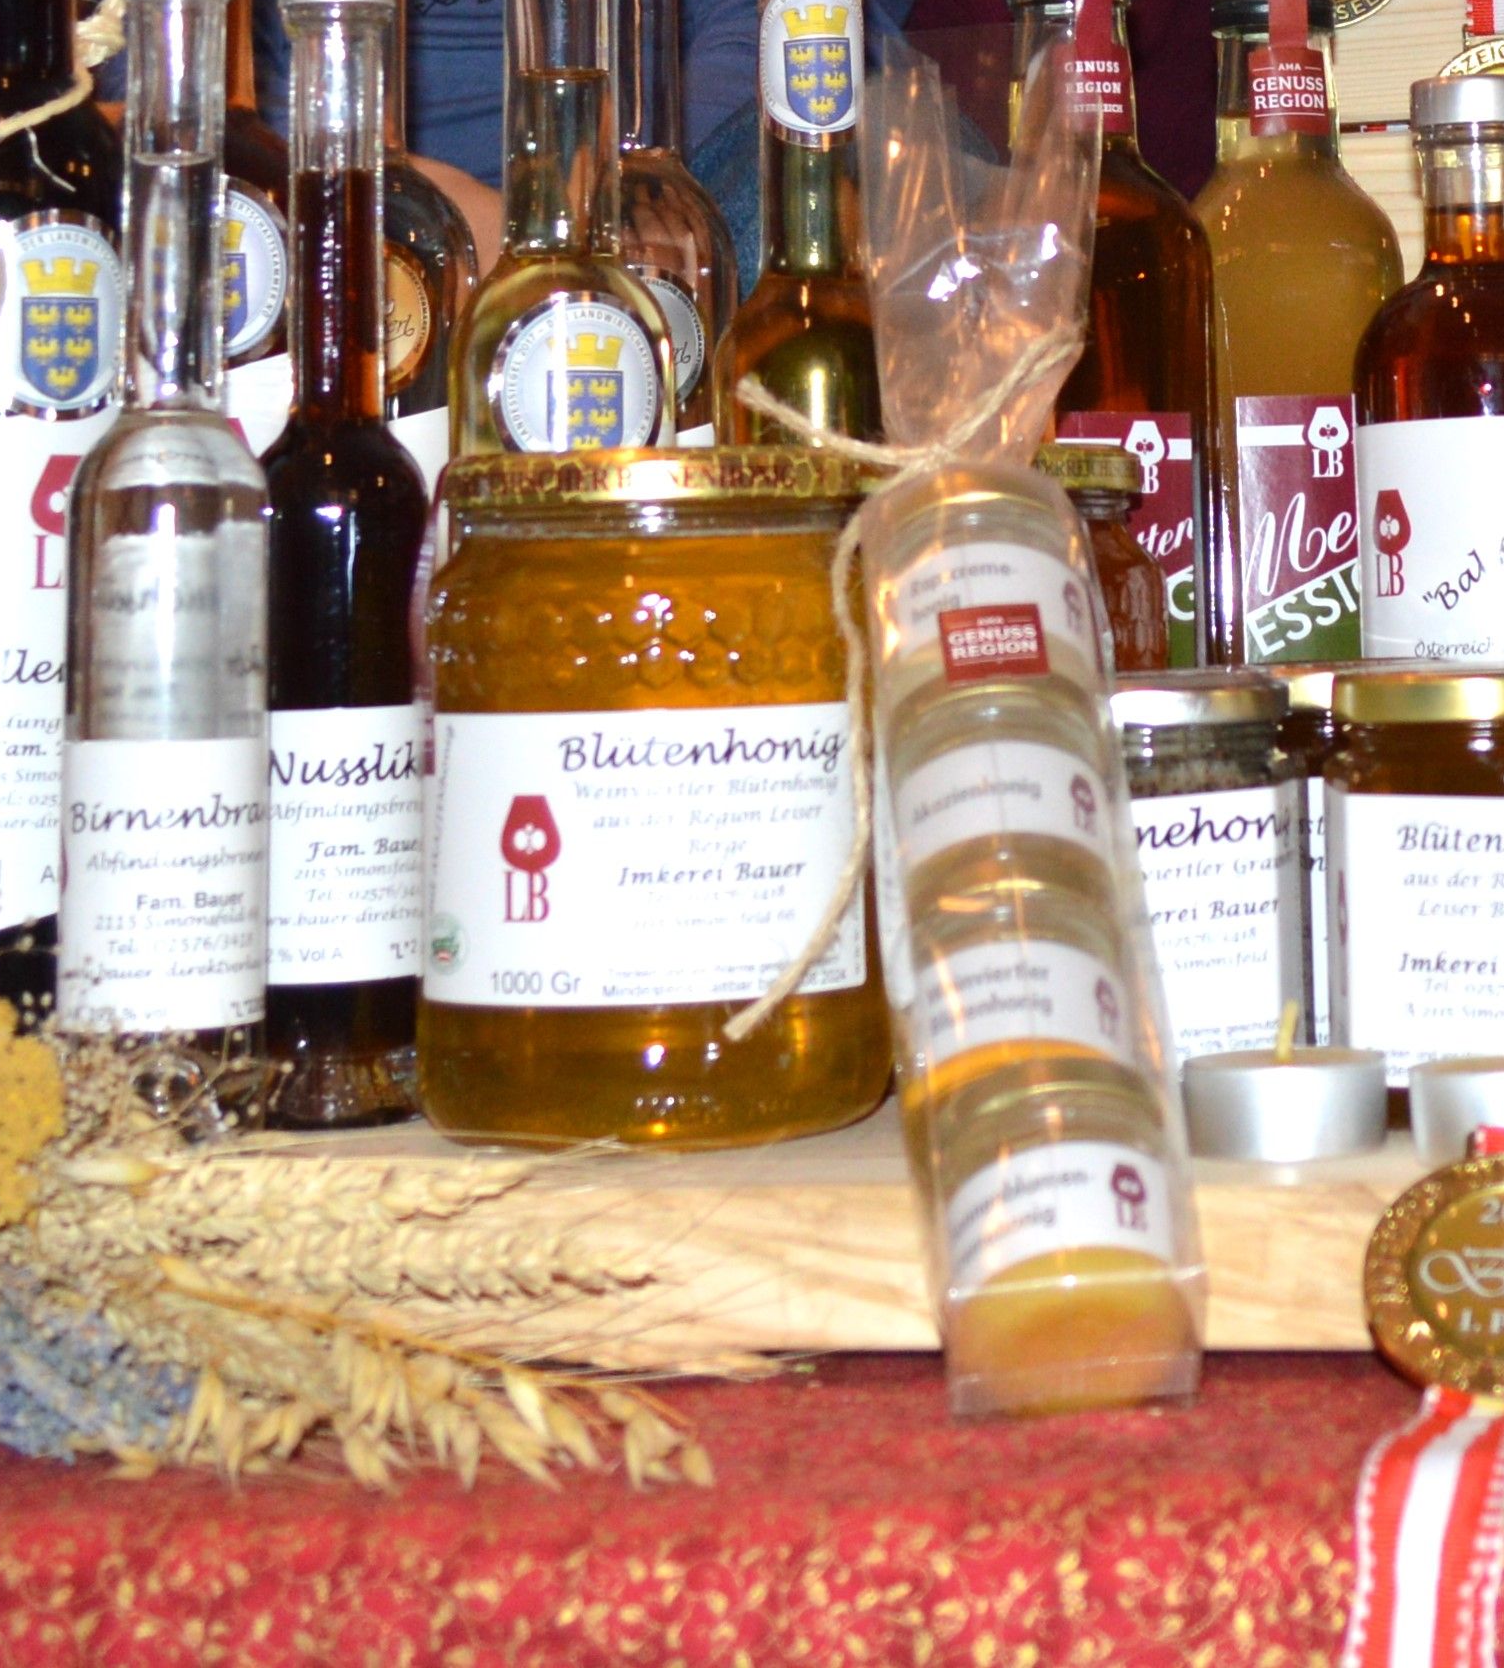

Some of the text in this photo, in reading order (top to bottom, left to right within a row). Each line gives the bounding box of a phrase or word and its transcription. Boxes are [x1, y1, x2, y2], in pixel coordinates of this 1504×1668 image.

[1277, 62, 1302, 71] AMA
[1252, 76, 1324, 94] GENUSS
[1254, 93, 1325, 111] REGION
[1311, 448, 1345, 478] LB
[1377, 553, 1405, 598] LB
[947, 624, 1037, 645] GENUSS
[950, 639, 1038, 661] REGION
[3, 741, 47, 757] am.
[558, 727, 847, 775] Blütenhonig
[269, 740, 419, 787] Nusslik
[70, 792, 265, 834] Birnenbra
[305, 837, 419, 863] Fam. Baue
[617, 860, 807, 887] Imkerei Bauer
[194, 891, 245, 909] Bauer
[503, 870, 551, 924] LB
[1398, 950, 1498, 975] Imkerei
[490, 970, 543, 995] 1000
[551, 969, 583, 996] Gr
